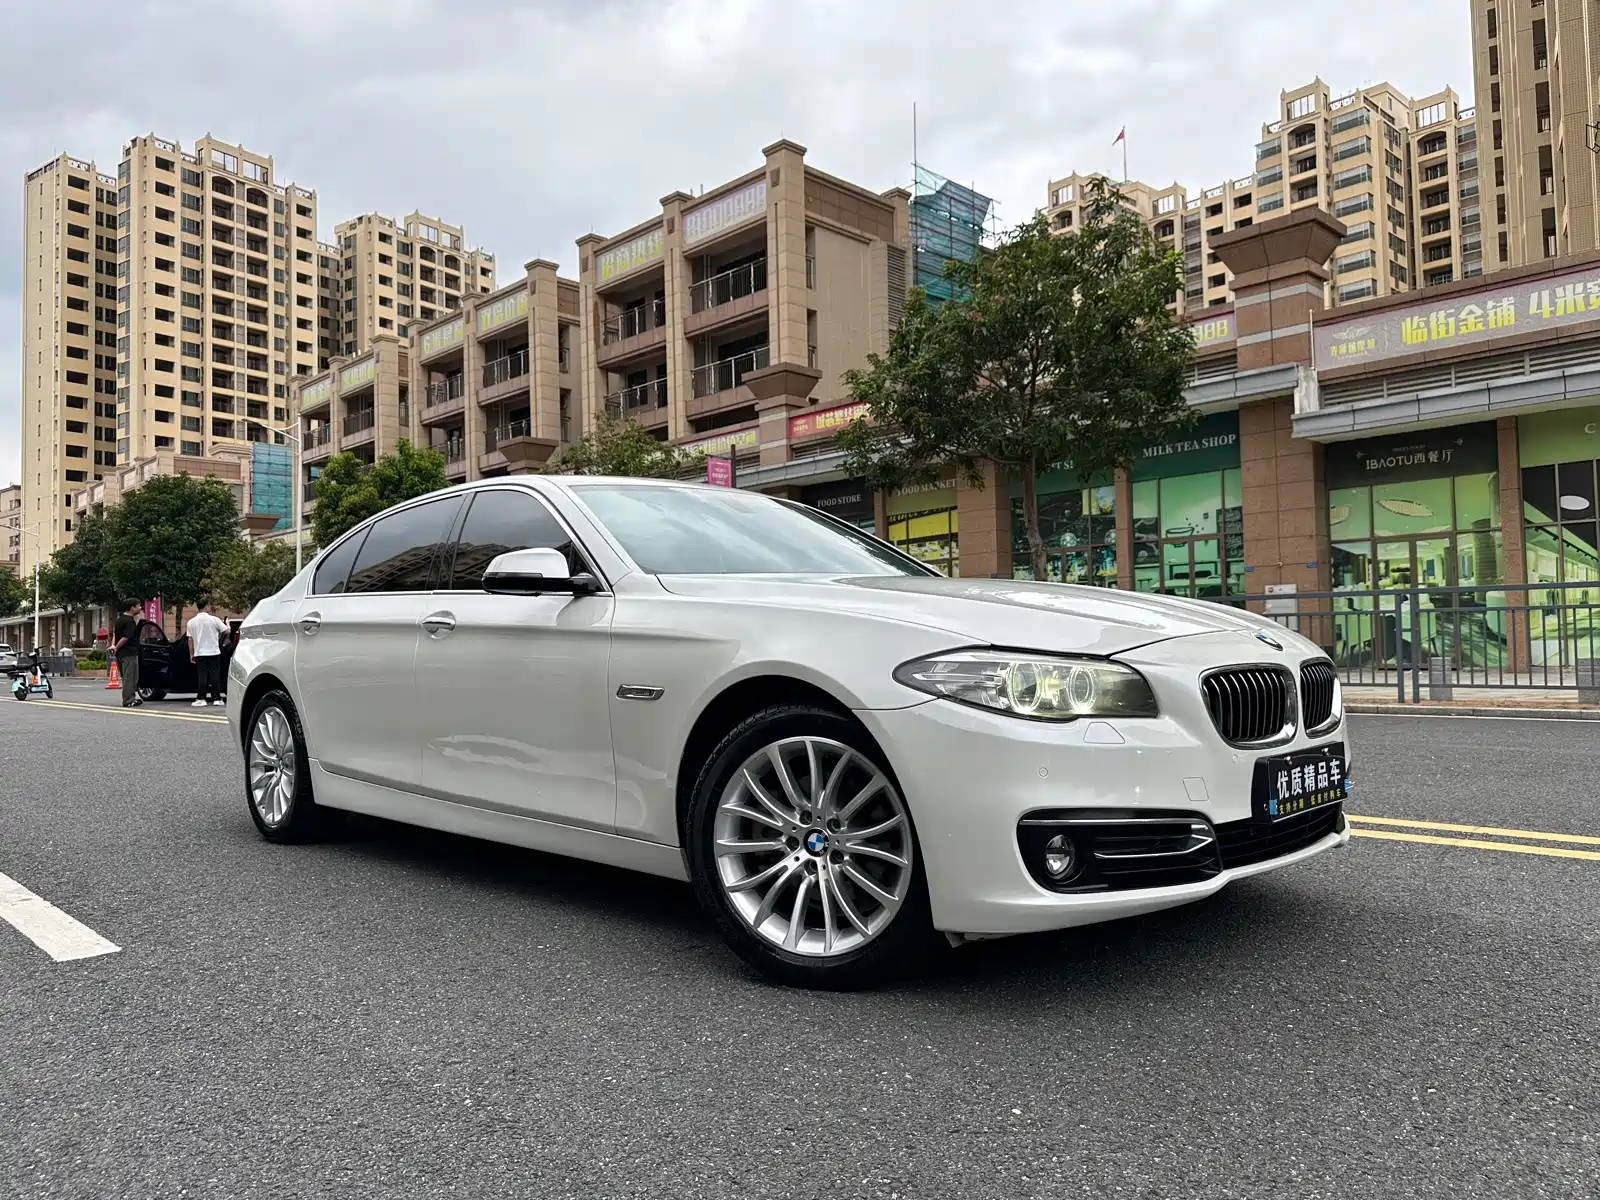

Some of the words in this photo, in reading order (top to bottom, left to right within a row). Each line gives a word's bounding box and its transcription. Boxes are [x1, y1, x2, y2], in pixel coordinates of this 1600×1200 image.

[1402, 296, 1516, 345] 临街金铺
[1142, 443, 1173, 458] MILK
[1175, 440, 1200, 452] TEA
[1202, 434, 1236, 448] SHOP
[837, 493, 861, 505] STORE
[1276, 759, 1341, 799] 优质精品车
